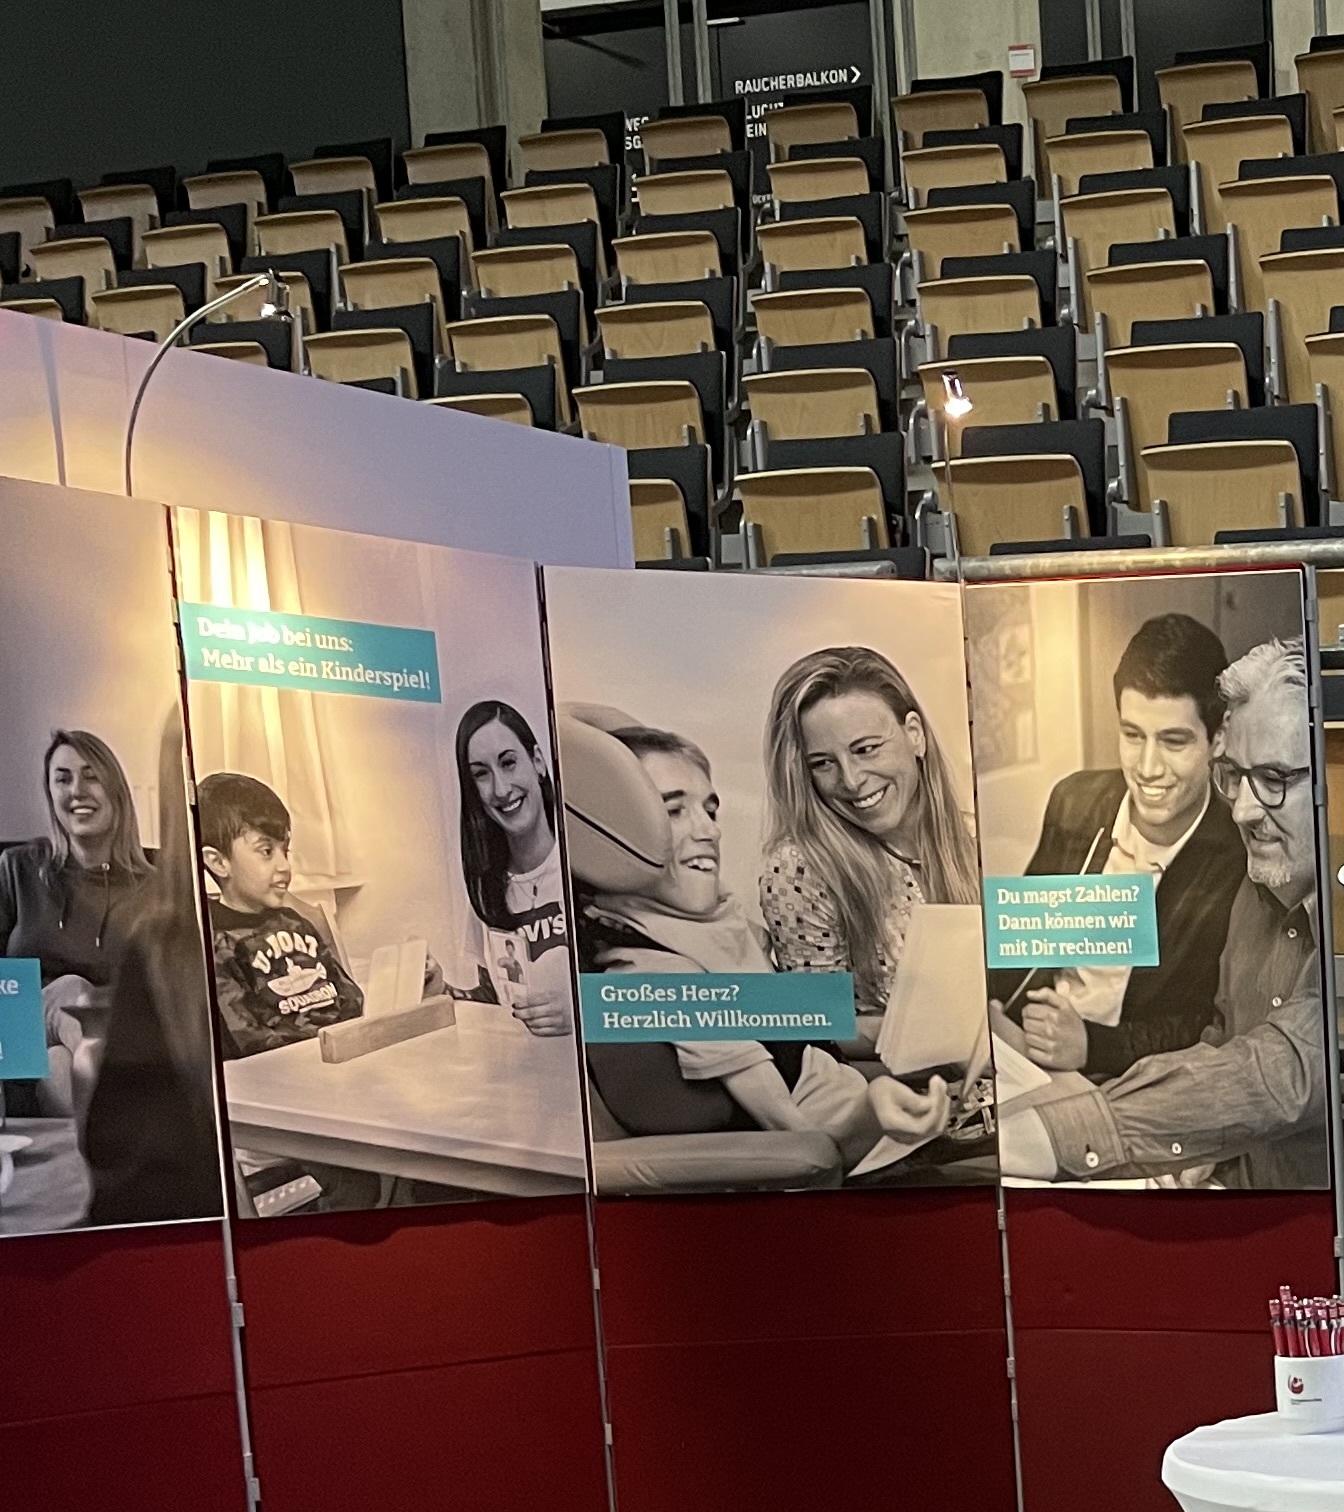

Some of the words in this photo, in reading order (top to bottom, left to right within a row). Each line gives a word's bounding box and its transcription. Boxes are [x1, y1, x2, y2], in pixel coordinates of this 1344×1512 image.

[735, 68, 848, 95] RAUCHERBALKON
[196, 616, 246, 640] Dein
[247, 621, 281, 645] Job
[282, 625, 312, 648] bei
[315, 632, 354, 652] uns:
[201, 648, 254, 672] Mehr
[258, 653, 286, 675] als
[288, 657, 318, 679] ein
[321, 660, 432, 692] Kinderspiel!
[997, 888, 1021, 905] Du
[1023, 887, 1072, 908] magst
[1075, 884, 1140, 903] Zahlen?
[998, 914, 1042, 931] Dann
[1044, 911, 1106, 929] können
[1108, 911, 1137, 928] wir
[999, 939, 1028, 956] mit
[1031, 938, 1056, 956] Dir
[1059, 937, 1133, 956] rechnen!
[601, 983, 677, 1002] Großes
[681, 984, 740, 1002] Herz?
[603, 1010, 692, 1029] Herzlich
[695, 1010, 833, 1028] Willkommen.
